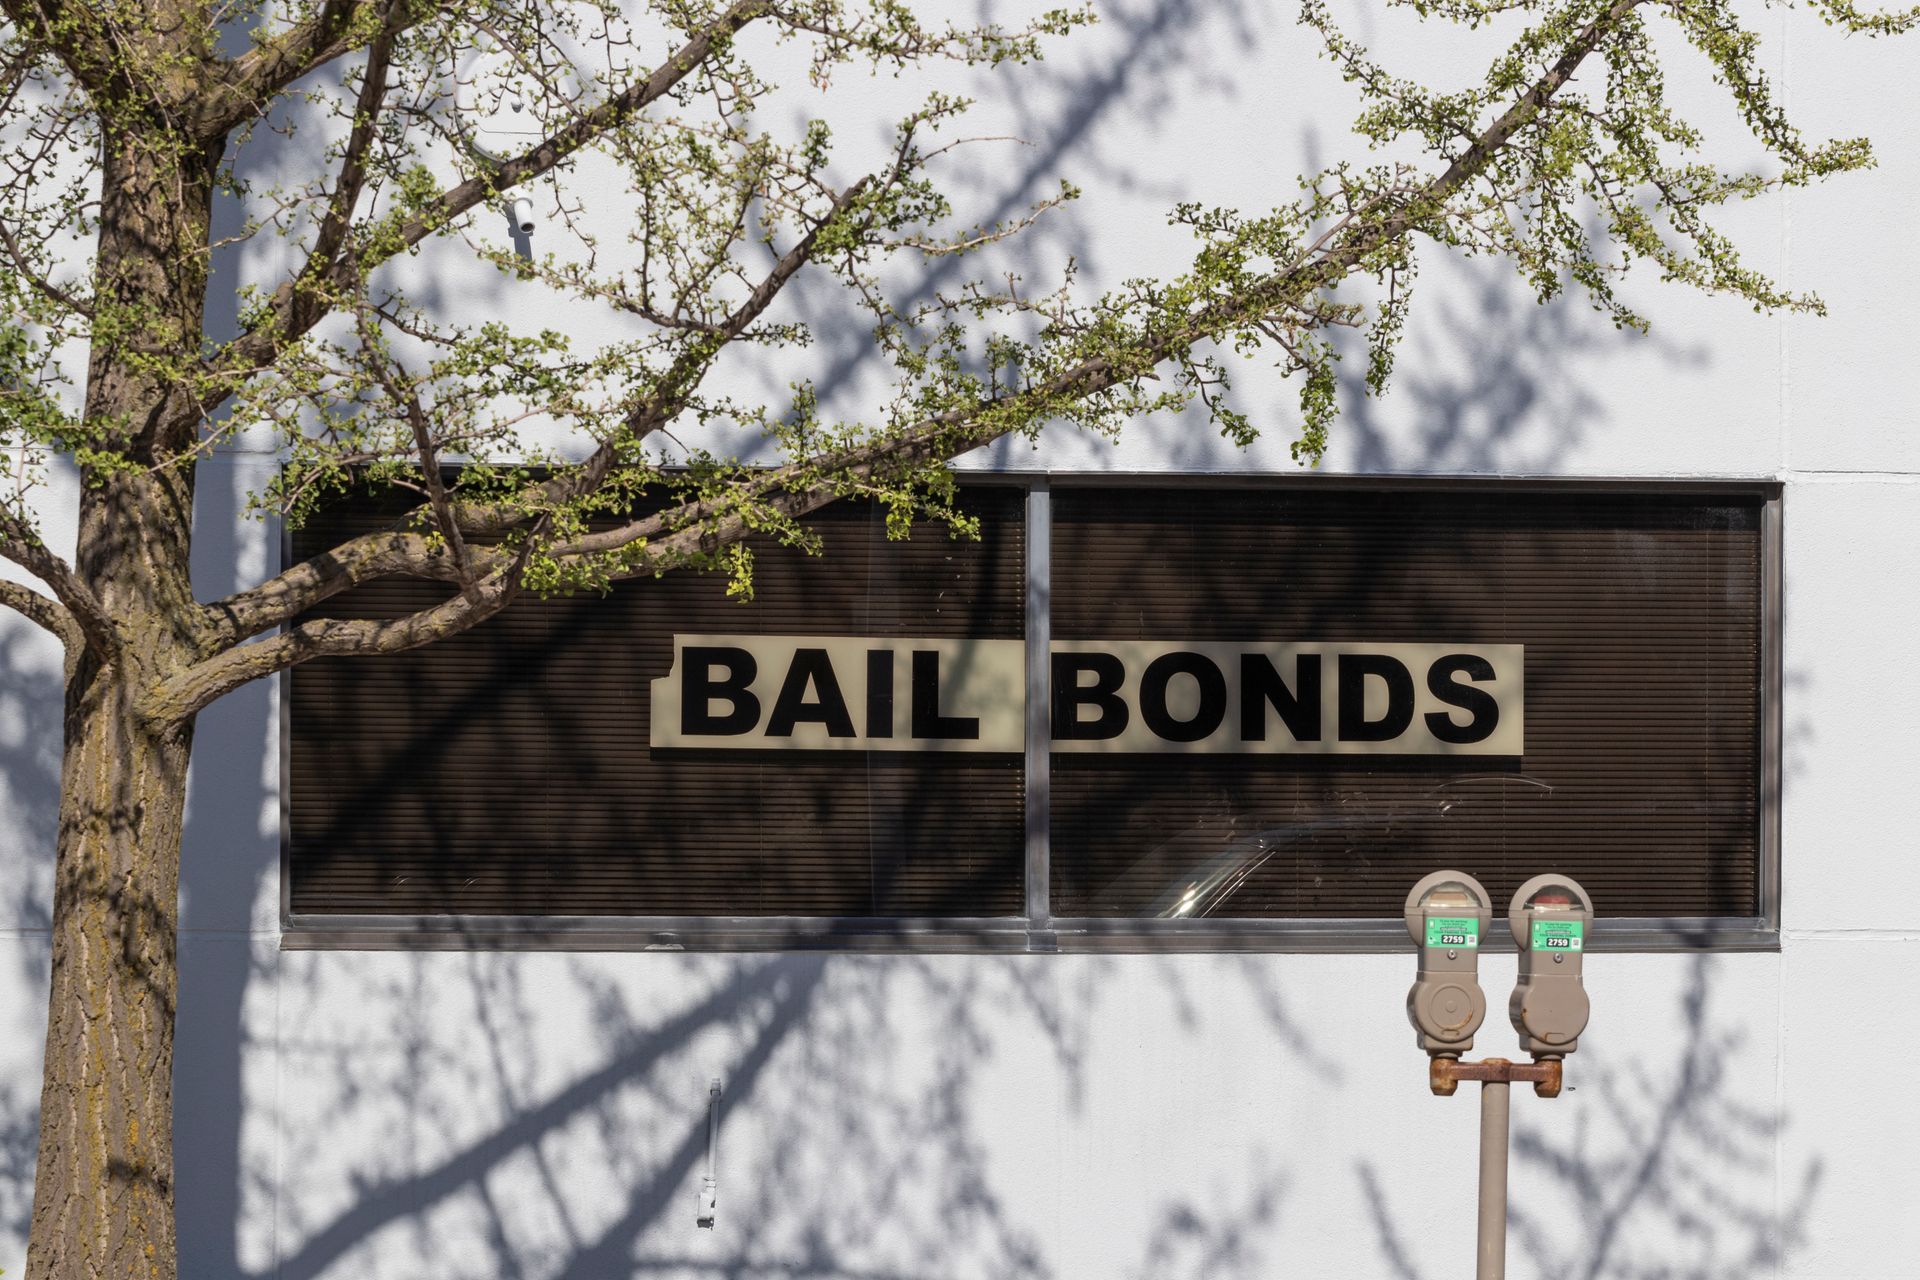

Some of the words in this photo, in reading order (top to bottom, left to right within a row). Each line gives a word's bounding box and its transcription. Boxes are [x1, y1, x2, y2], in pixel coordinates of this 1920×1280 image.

[682, 647, 980, 740] BAIL
[1051, 652, 1500, 744] BONDS
[1442, 935, 1464, 944] 2759
[1548, 938, 1569, 947] 2759
